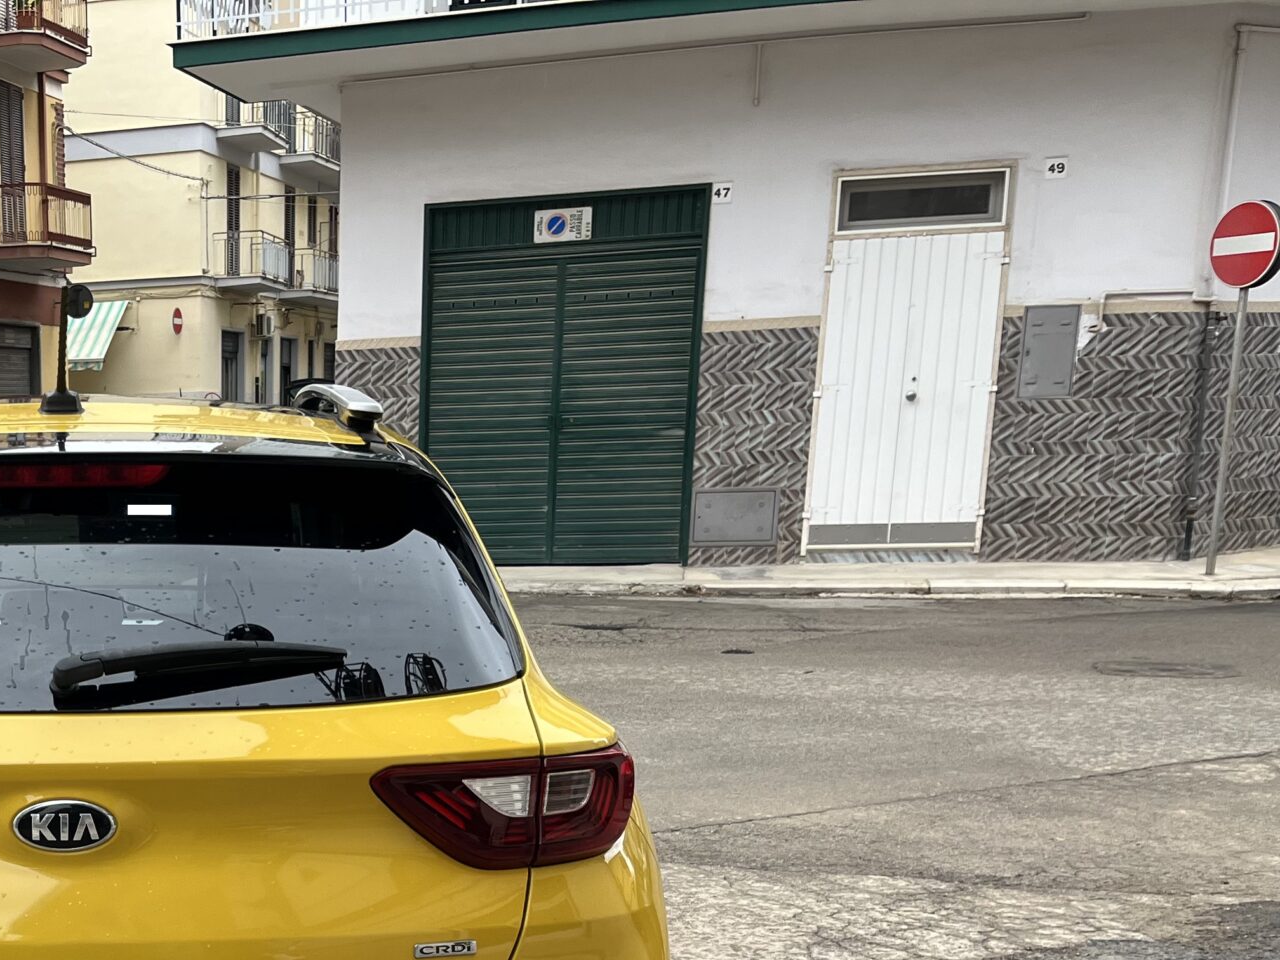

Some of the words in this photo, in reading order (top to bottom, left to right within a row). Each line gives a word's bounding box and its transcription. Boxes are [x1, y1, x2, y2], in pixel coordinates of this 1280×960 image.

[1047, 162, 1066, 174] 49
[714, 187, 731, 198] 47
[569, 213, 577, 233] PASSO
[575, 209, 584, 239] CARRABILE
[30, 813, 100, 841] KIA
